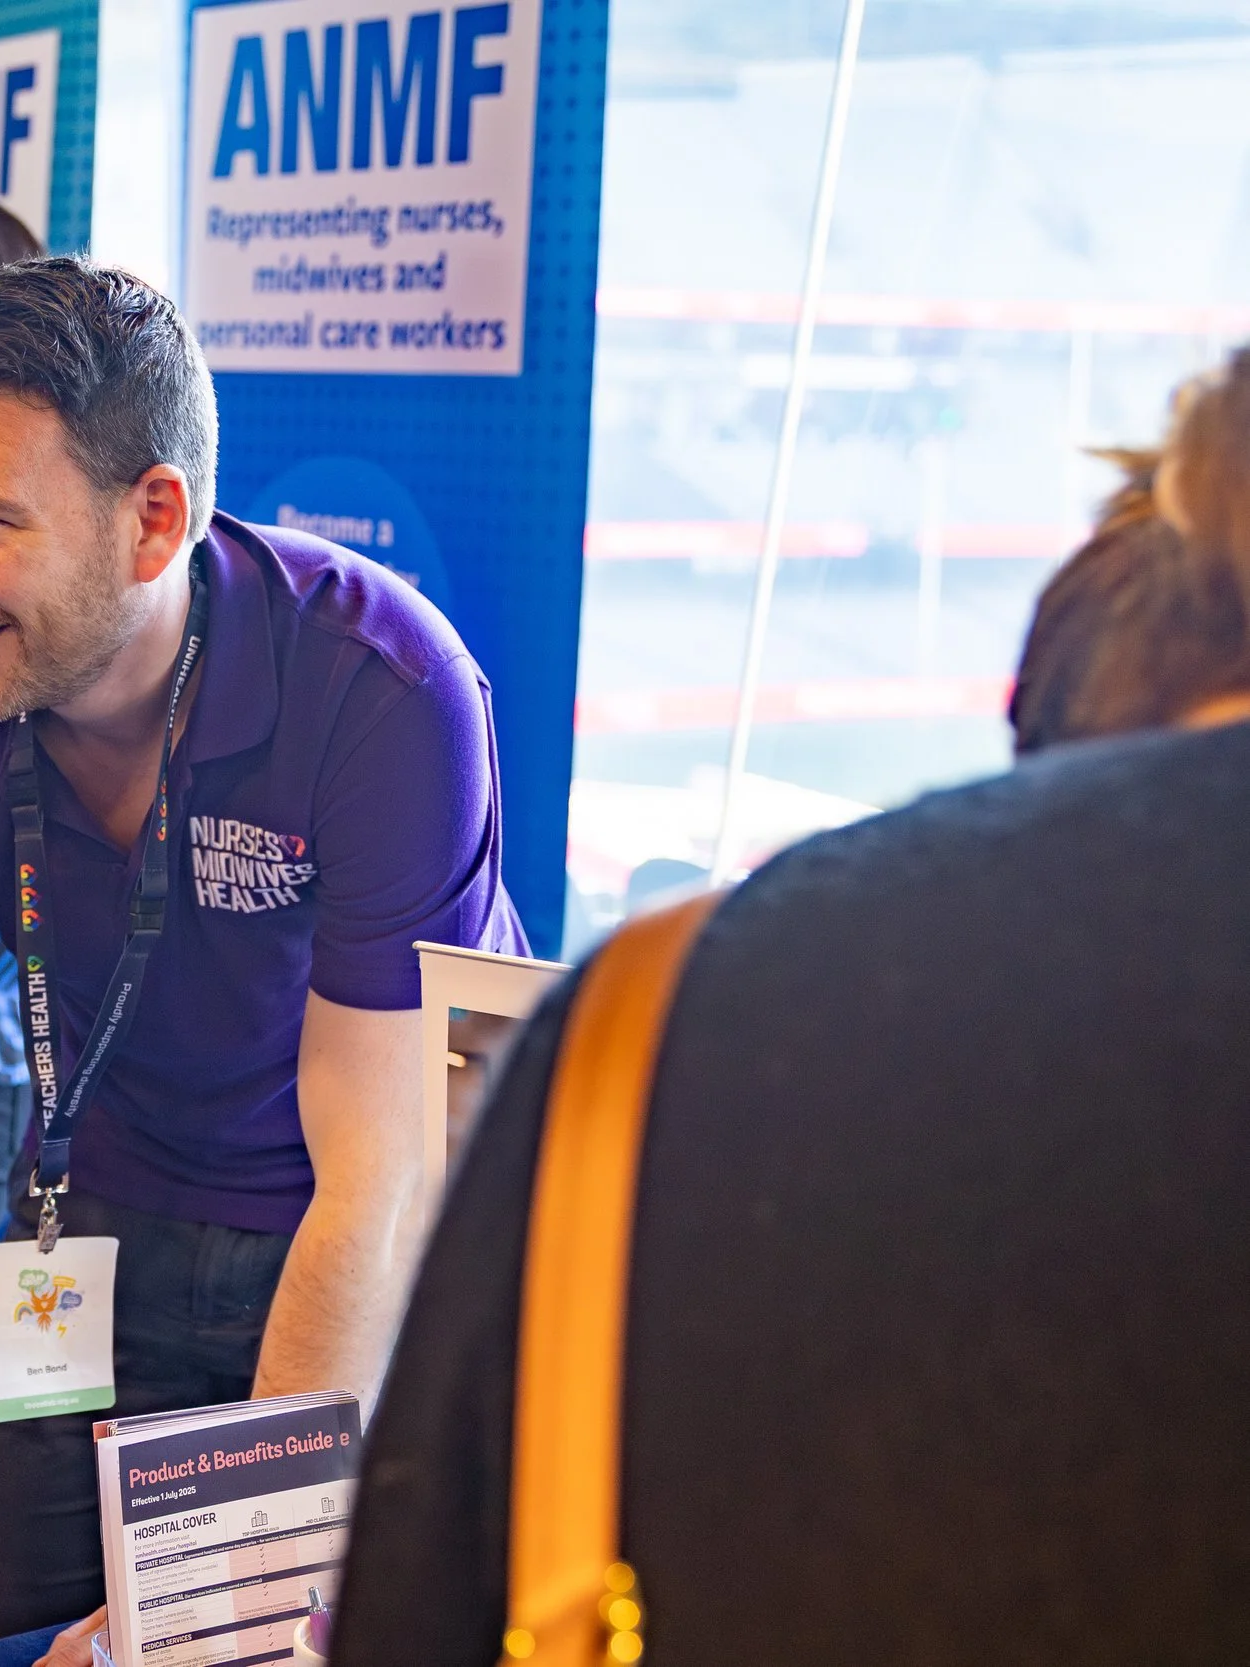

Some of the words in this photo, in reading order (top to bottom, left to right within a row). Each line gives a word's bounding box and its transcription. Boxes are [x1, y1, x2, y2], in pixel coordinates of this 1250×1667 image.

[210, 3, 510, 180] ANMF
[207, 195, 390, 247] Representing
[397, 198, 505, 238] nurses,
[254, 253, 388, 292] midwives
[392, 252, 446, 291] and
[198, 311, 313, 353] personal
[319, 321, 377, 349] care
[388, 310, 506, 349] workers
[377, 519, 395, 547] a
[189, 816, 283, 862] NURSES
[192, 848, 317, 887] MIDWIVES
[195, 878, 301, 913] HEALTH
[28, 972, 50, 1037] HEALTH
[108, 983, 132, 1024] Proudly
[82, 1025, 116, 1075] supporting
[64, 1076, 89, 1118] diversity
[27, 1367, 43, 1375] Ben
[129, 1458, 195, 1488] Product
[197, 1453, 211, 1473] &
[213, 1442, 283, 1470] Benefits
[286, 1431, 333, 1455] Guide
[131, 1494, 160, 1507] Effective
[160, 1493, 164, 1501] 1
[164, 1490, 178, 1500] July
[178, 1485, 197, 1497] 2025
[134, 1520, 181, 1540] HOSPITAL
[183, 1512, 217, 1530] COVER
[136, 1560, 159, 1570] PRIVATE
[159, 1554, 184, 1566] HOSPITAL
[139, 1600, 158, 1609] PUBLIC
[158, 1594, 184, 1604] HOSPITAL
[142, 1641, 165, 1651] MEDICAL
[165, 1634, 192, 1645] SERVICES
